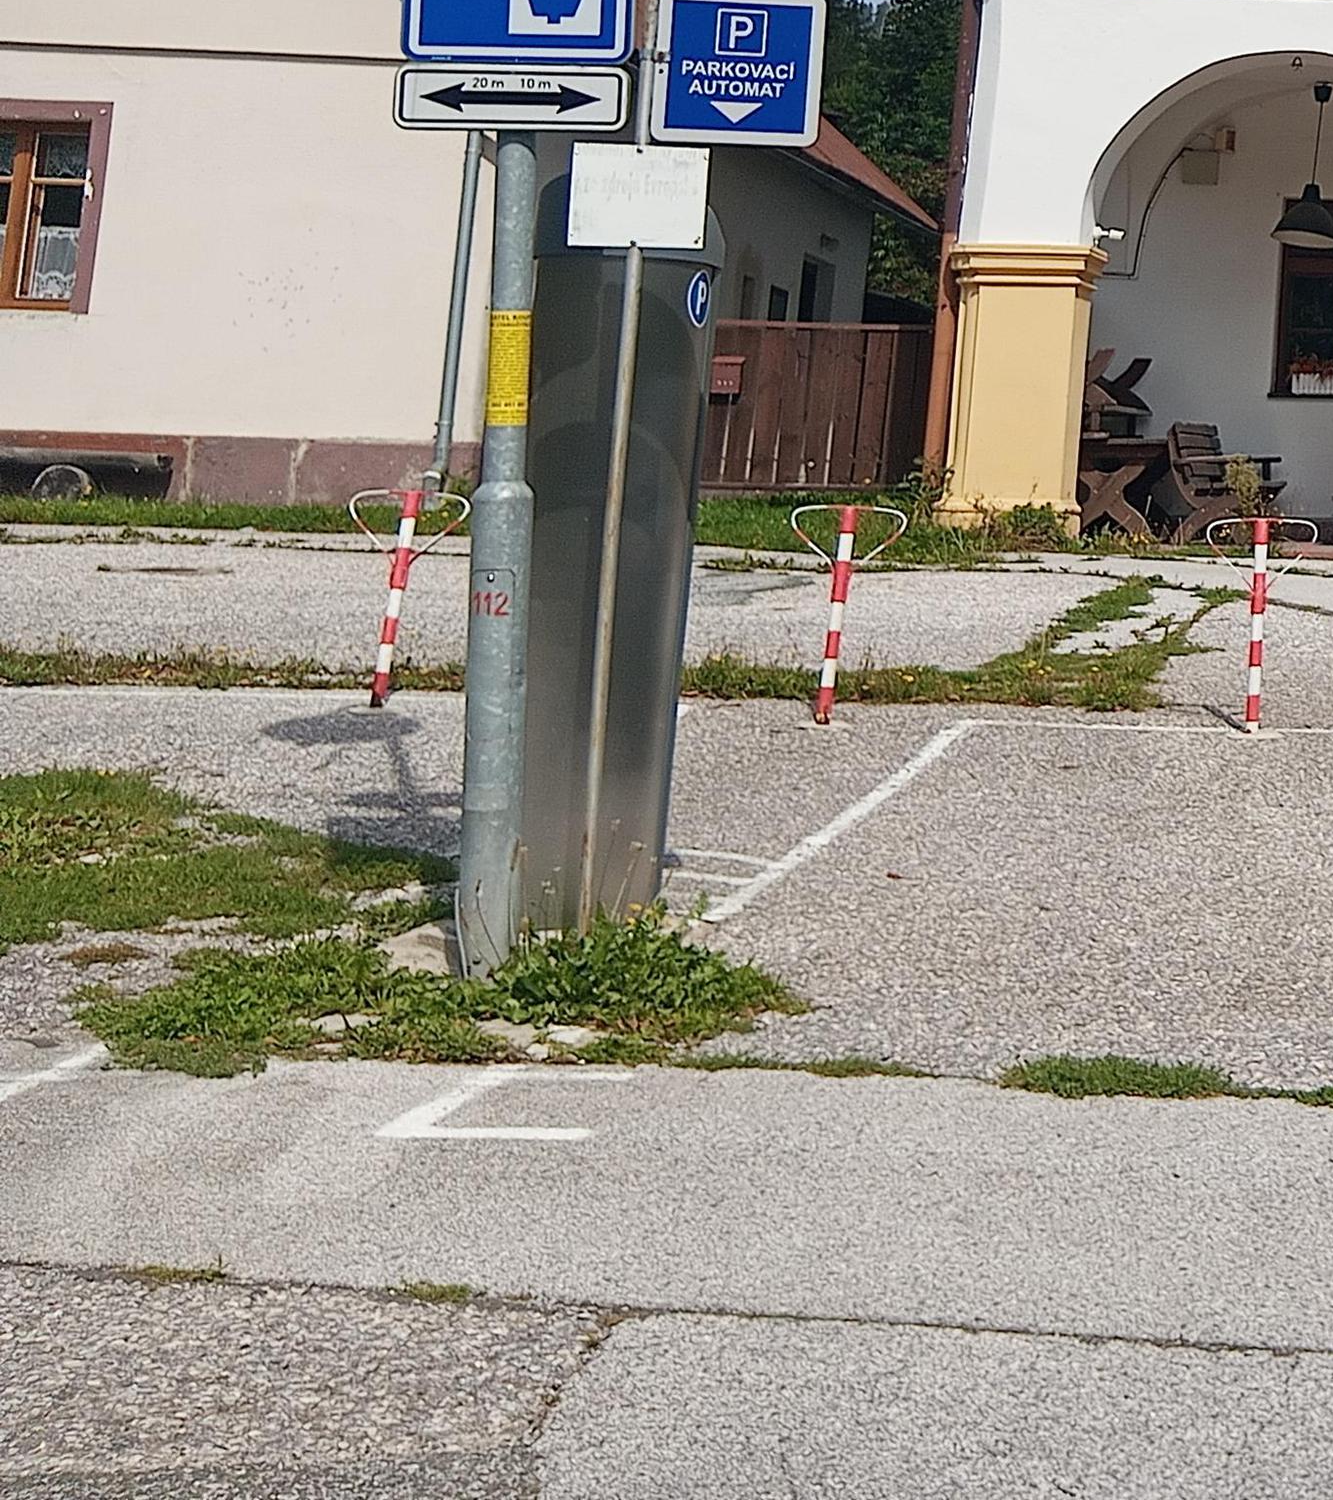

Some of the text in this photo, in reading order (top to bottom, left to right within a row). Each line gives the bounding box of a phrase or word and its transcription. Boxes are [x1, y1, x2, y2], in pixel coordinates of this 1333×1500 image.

[729, 15, 754, 49] P
[681, 60, 795, 80] PARKOVACÍ
[472, 77, 551, 90] 20 m 10 m
[688, 79, 784, 98] AUTOMAT
[696, 280, 707, 315] P
[474, 591, 509, 616] 112
